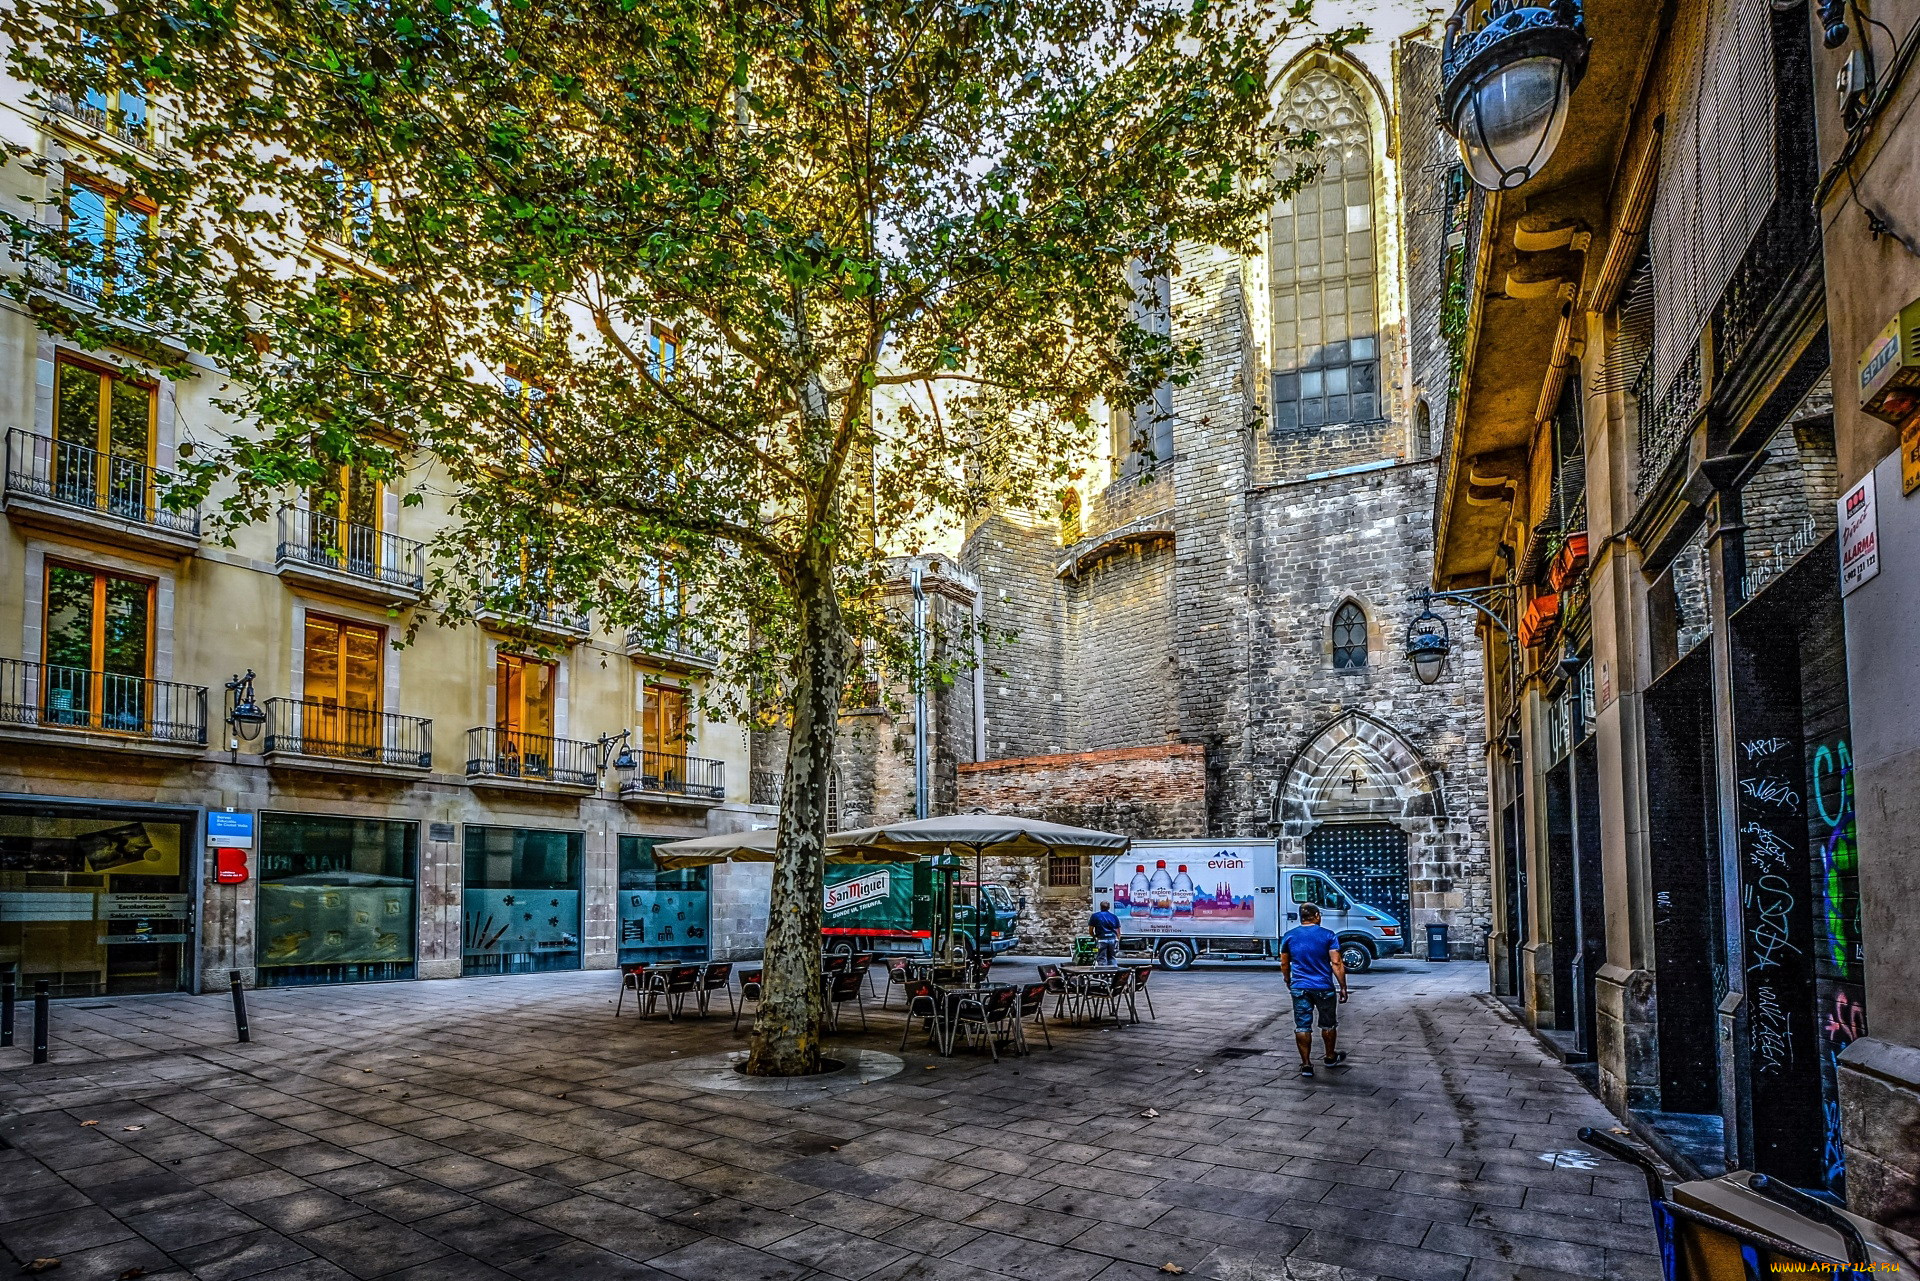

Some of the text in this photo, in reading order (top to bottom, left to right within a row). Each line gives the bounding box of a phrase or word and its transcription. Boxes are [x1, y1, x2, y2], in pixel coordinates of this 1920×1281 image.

[1862, 338, 1896, 386] SPITZ
[1843, 532, 1875, 566] ALARMA
[1741, 559, 1771, 599] tapes
[1207, 858, 1244, 869] evian
[1151, 889, 1171, 897] explore
[832, 909, 850, 919] DONDE
